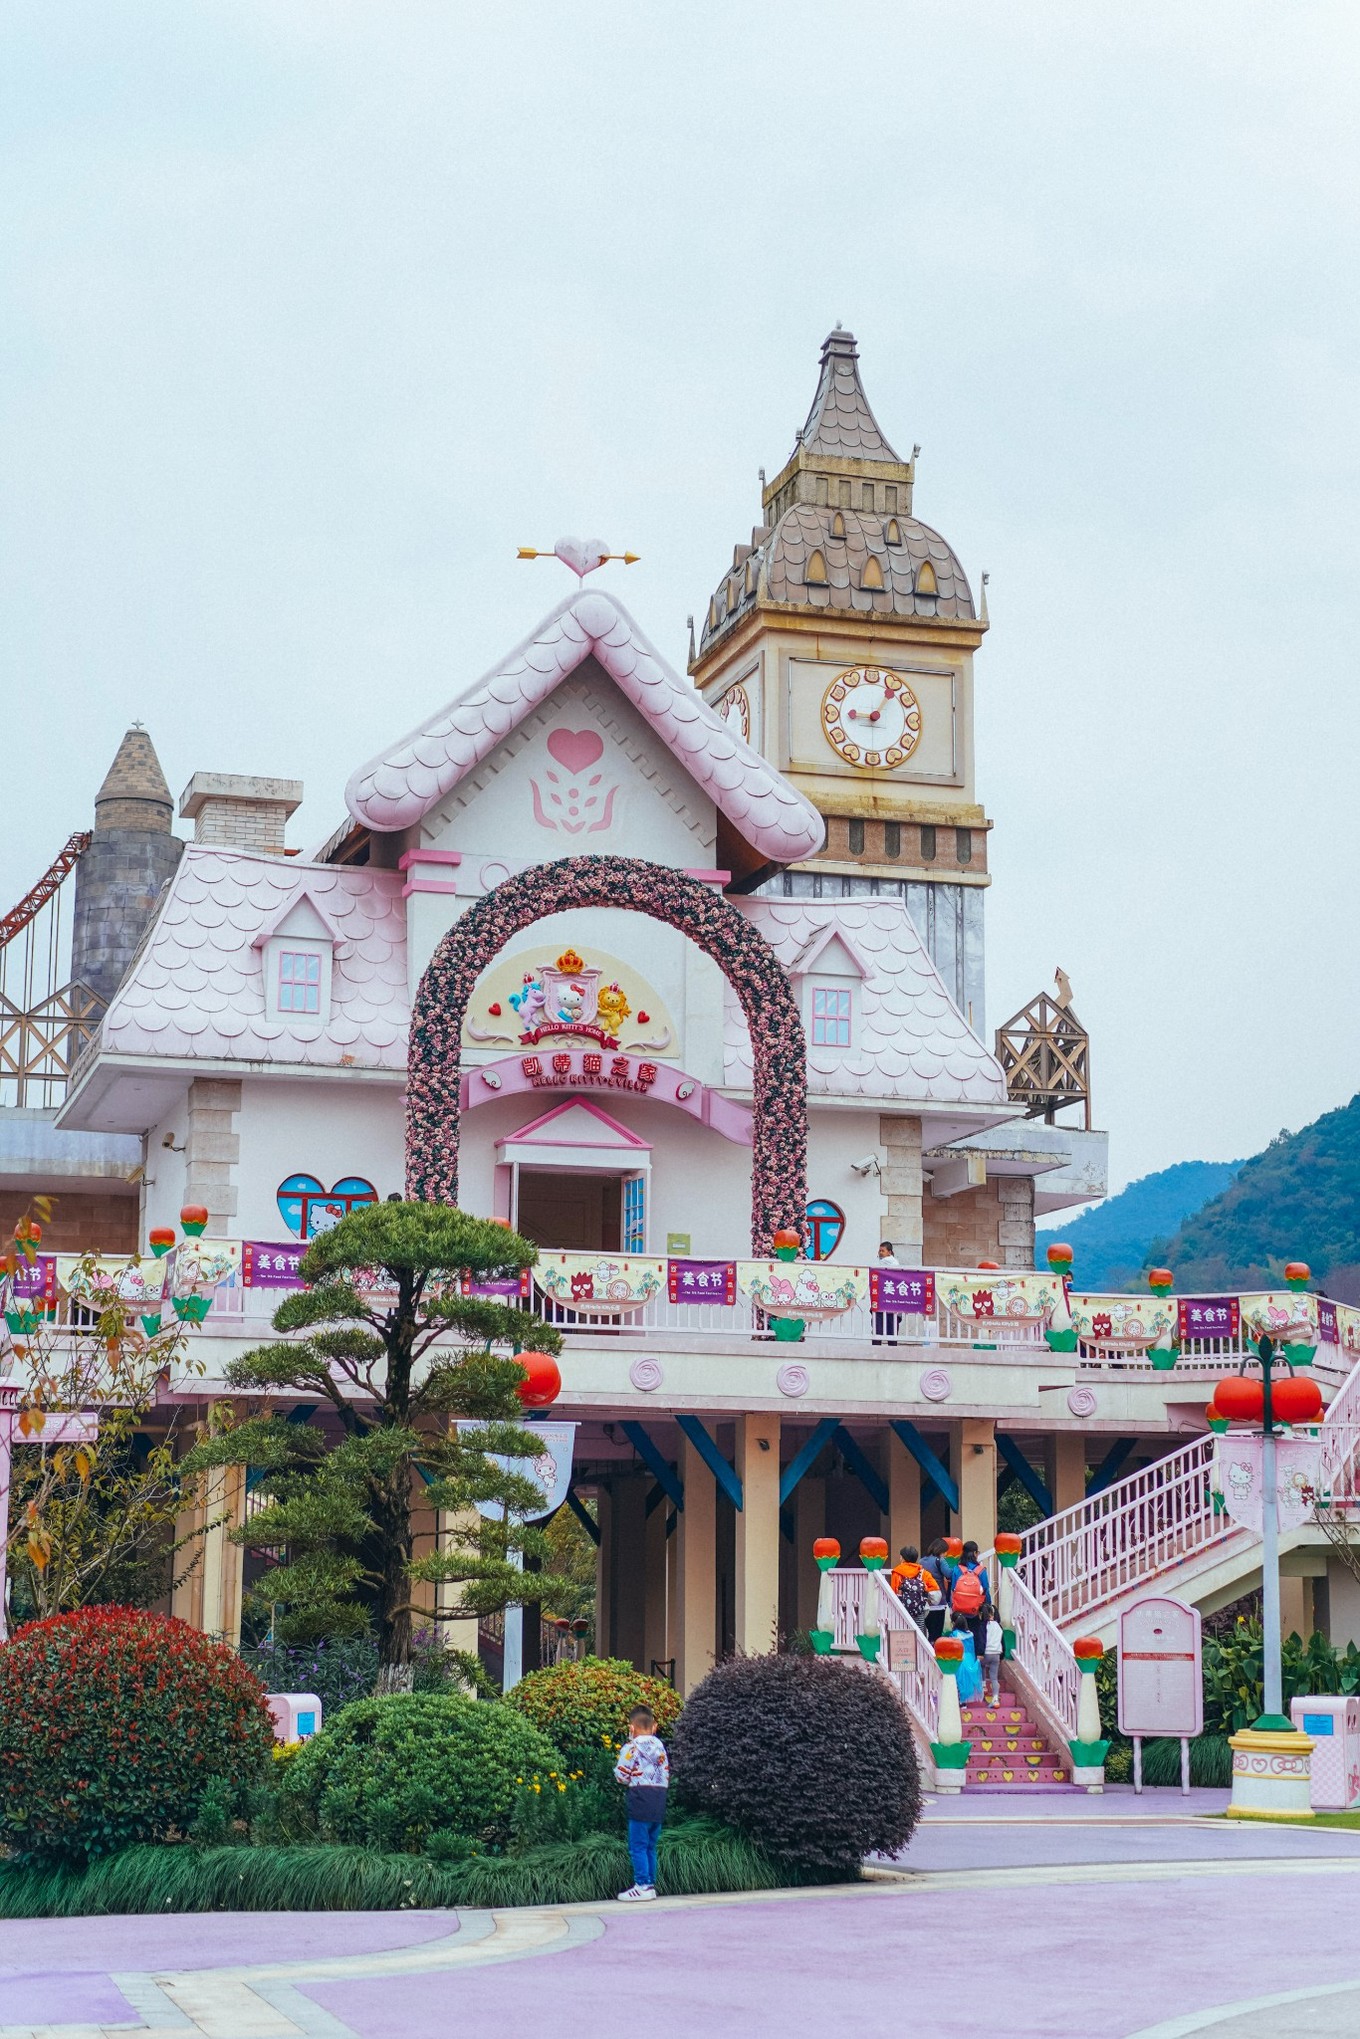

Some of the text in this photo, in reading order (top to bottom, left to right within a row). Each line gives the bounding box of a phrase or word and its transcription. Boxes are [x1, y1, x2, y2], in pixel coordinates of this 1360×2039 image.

[540, 1024, 560, 1033] HELLO
[586, 1027, 603, 1037] HOME
[521, 1053, 658, 1084] 凯蒂猫之家
[532, 1074, 567, 1087] HELLO
[257, 1253, 300, 1271] 美食节
[682, 1271, 723, 1287] 美食节
[883, 1280, 922, 1296] 美食节
[1190, 1308, 1228, 1322] 美食节
